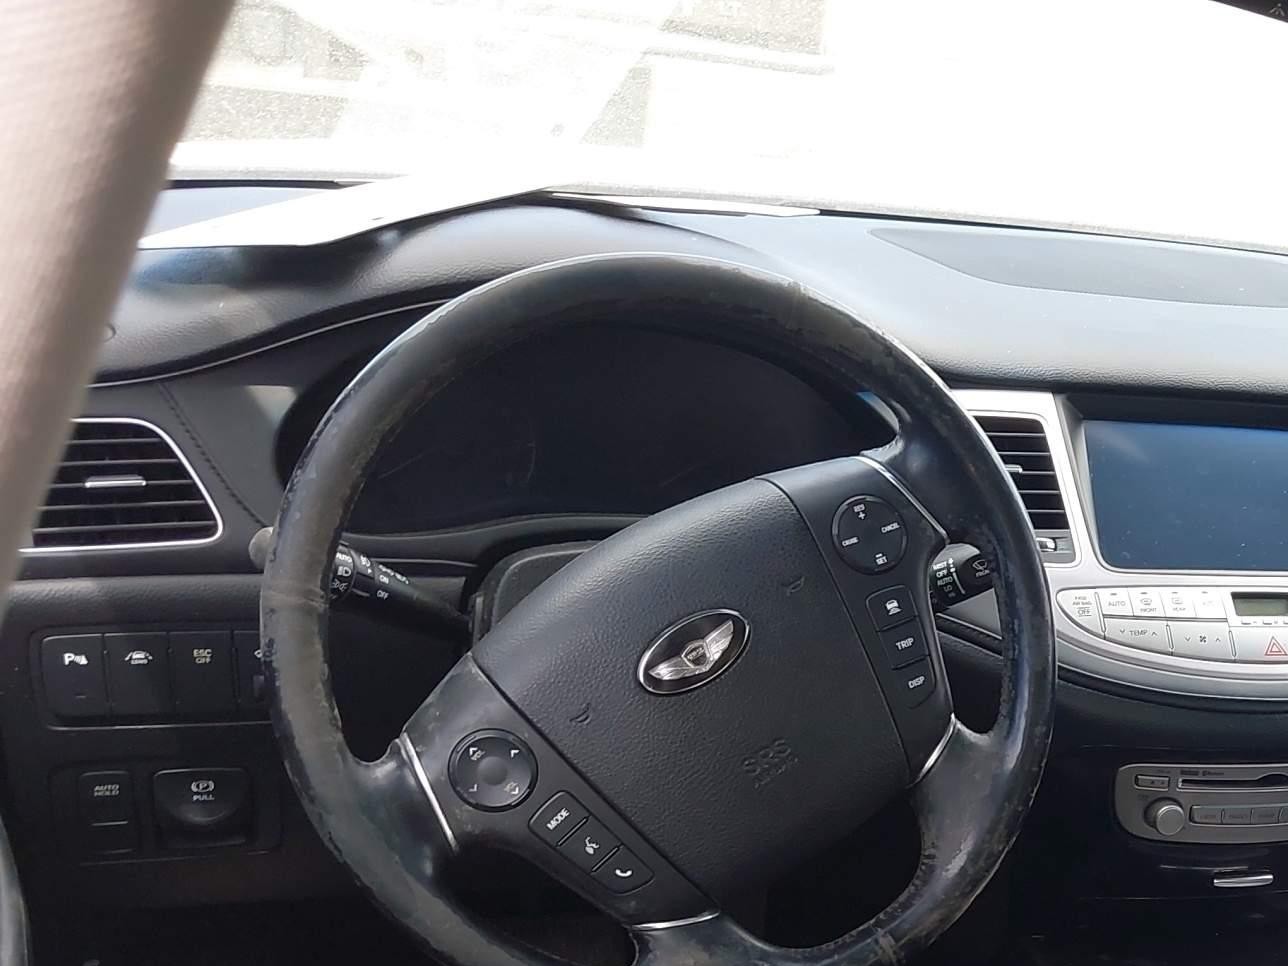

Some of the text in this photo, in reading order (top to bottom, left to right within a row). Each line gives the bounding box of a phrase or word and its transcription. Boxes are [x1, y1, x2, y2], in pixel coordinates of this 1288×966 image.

[881, 522, 900, 533] CANCEL
[336, 552, 352, 563] AUTO
[876, 556, 888, 565] SET
[936, 568, 948, 578] OFF
[379, 574, 389, 584] ON
[937, 576, 953, 586] AUTO
[377, 590, 389, 600] OFF
[1129, 629, 1148, 637] TEMP
[895, 637, 914, 651] TRIP
[193, 649, 212, 657] ESC
[908, 676, 925, 689] DISP
[94, 789, 120, 797] HOLD
[546, 807, 570, 830] MODE
